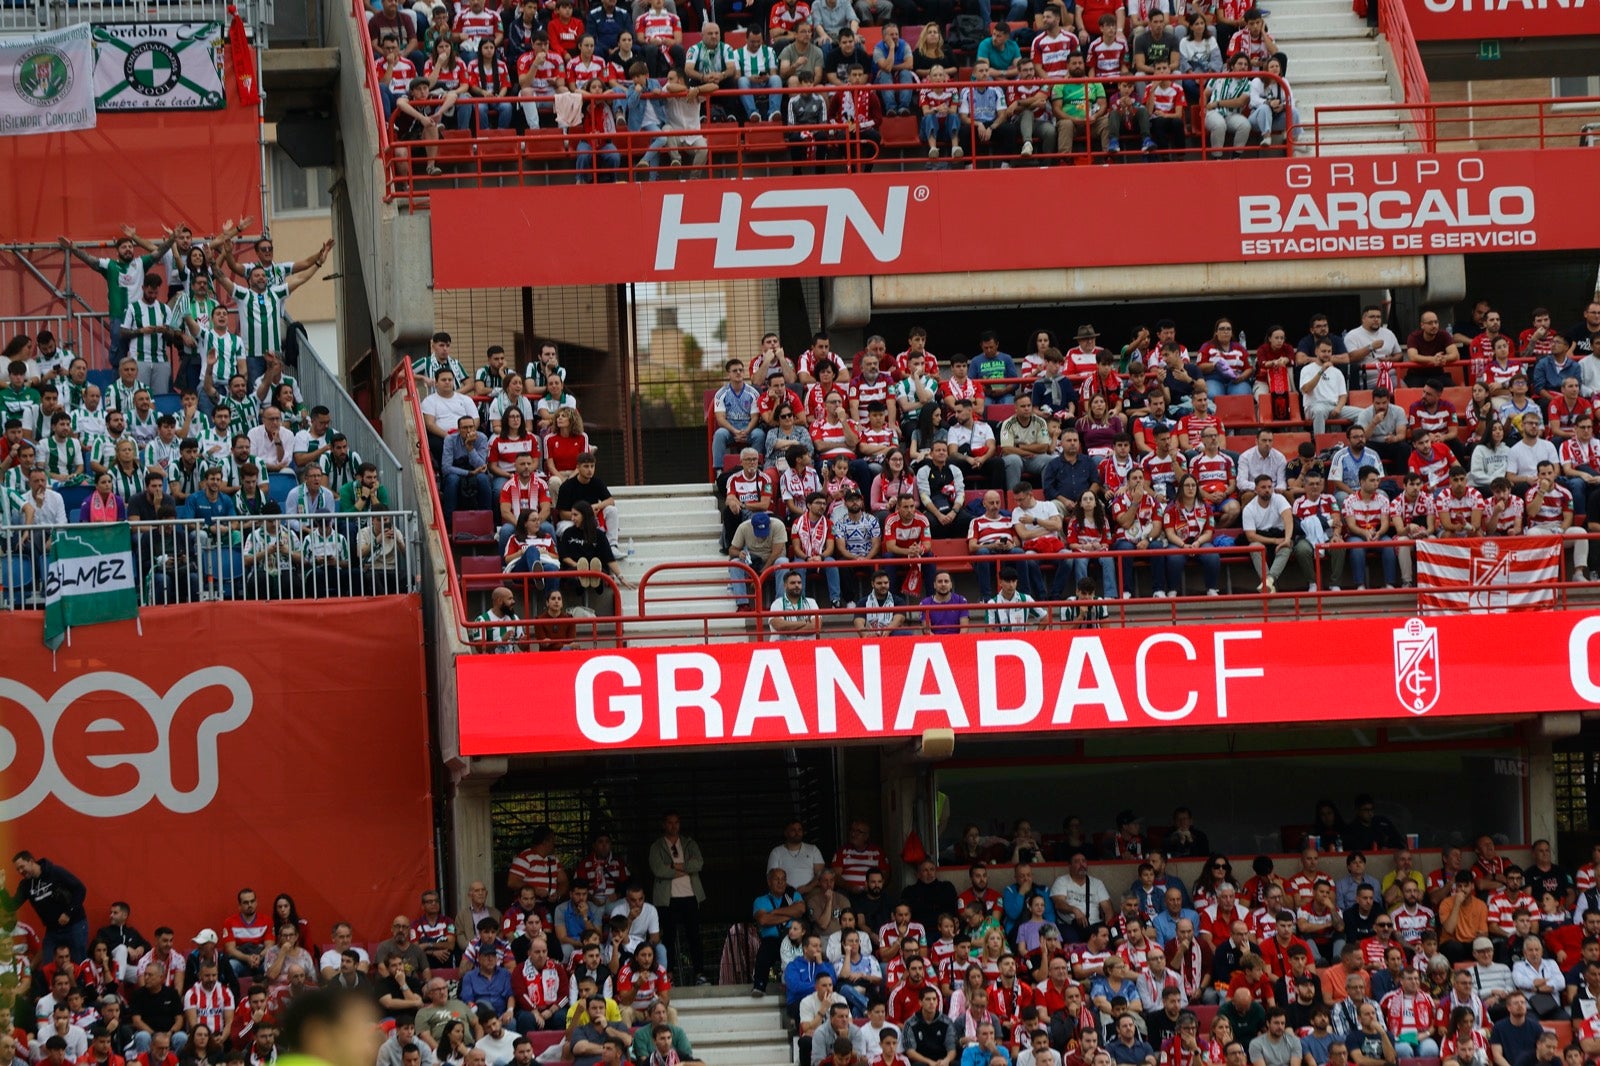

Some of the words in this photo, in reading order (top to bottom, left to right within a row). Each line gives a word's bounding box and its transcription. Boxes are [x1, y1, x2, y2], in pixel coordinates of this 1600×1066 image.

[136, 84, 171, 96] 2001
[1286, 157, 1484, 189] GRUPO
[654, 185, 910, 271] HSN
[1239, 185, 1536, 234] BARCALO
[1241, 235, 1385, 255] ESTACIONES
[1392, 233, 1423, 250] DE
[1430, 230, 1537, 249] SERVICIO
[46, 558, 126, 597] BLMEZ
[574, 636, 1128, 743] GRANADA
[1135, 630, 1264, 722] CF
